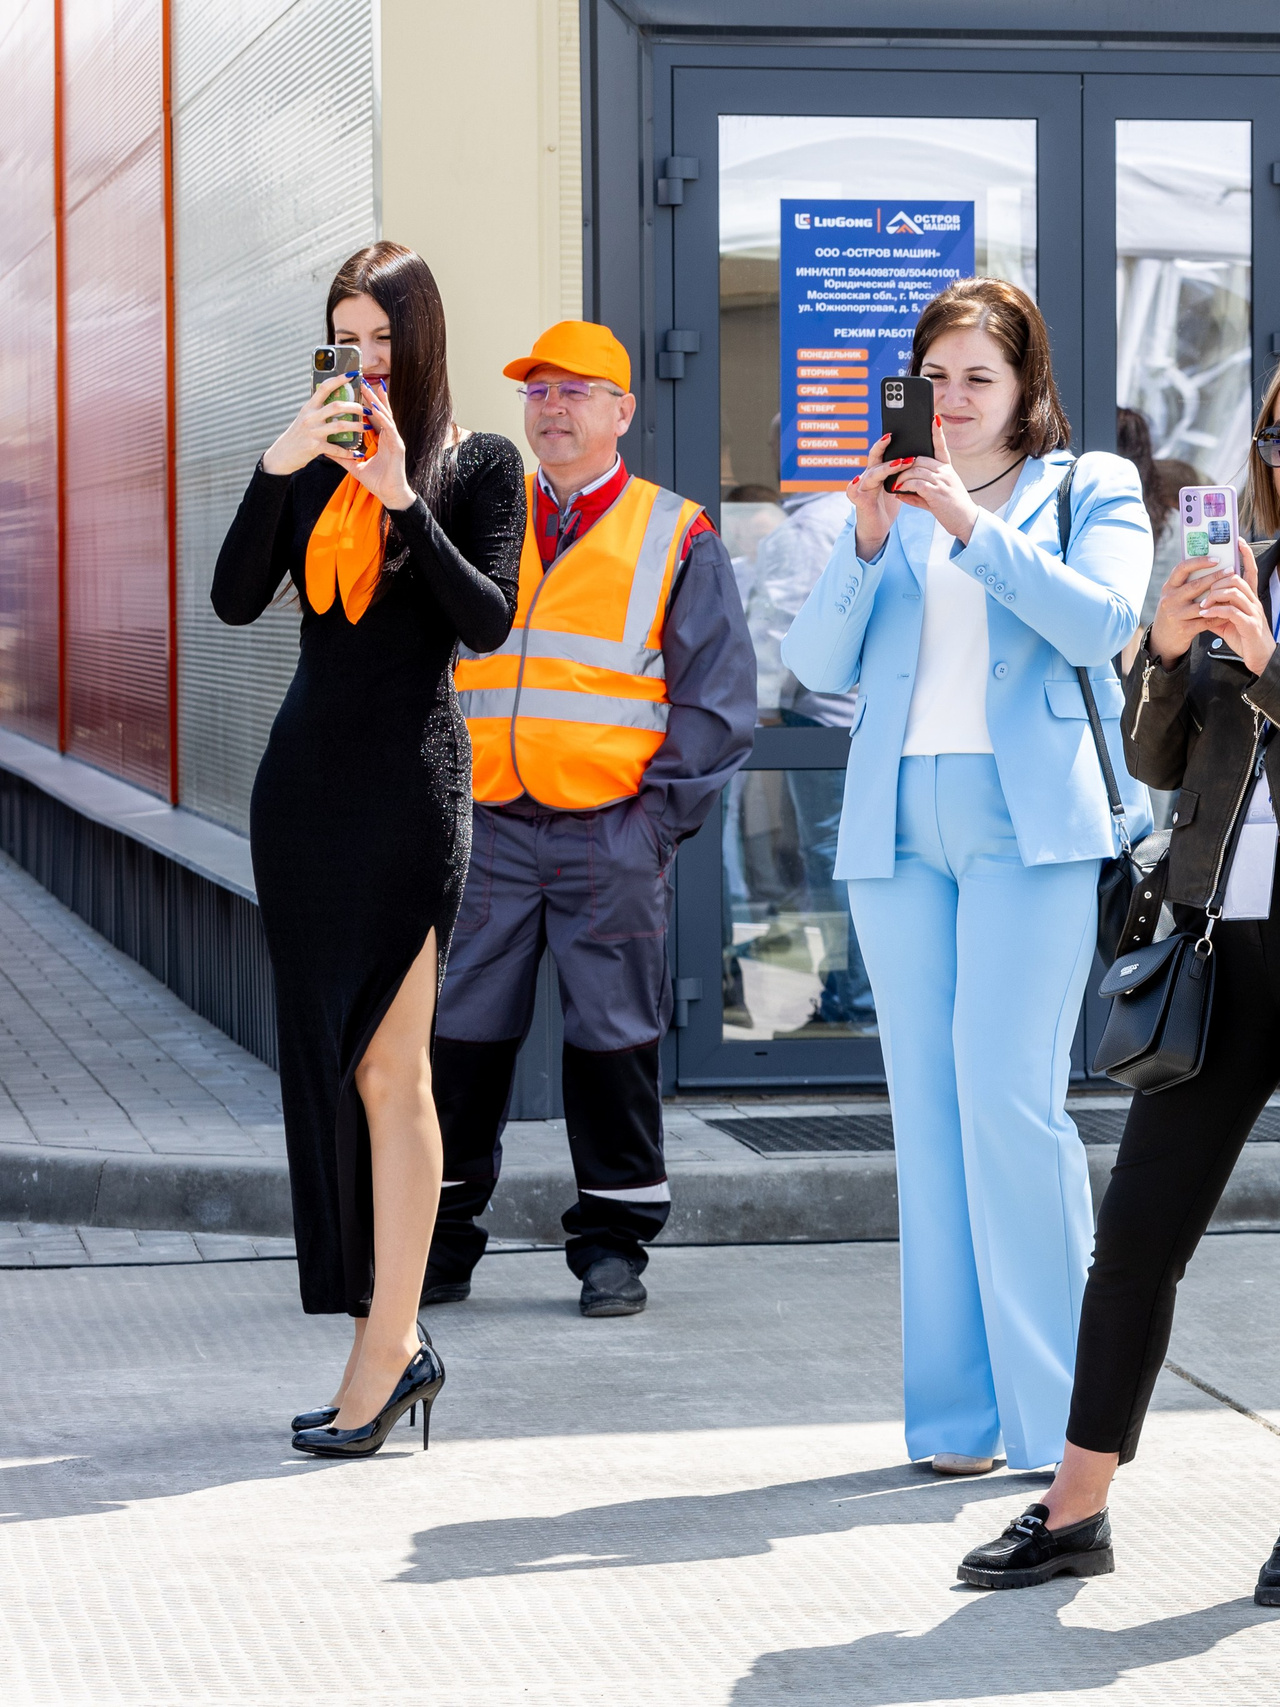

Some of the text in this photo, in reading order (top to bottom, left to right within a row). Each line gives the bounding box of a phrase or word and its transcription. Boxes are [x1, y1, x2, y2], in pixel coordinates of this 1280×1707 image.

[913, 214, 961, 224] ОСТРОВ
[923, 223, 961, 232] МАШИН
[814, 248, 941, 259] ООО «ОСТРОВ МАШИН»
[795, 267, 846, 278] ИНН/КПП
[823, 279, 932, 291] Юридический адрес:
[806, 291, 871, 301] Московская
[908, 291, 937, 302] Моск
[798, 304, 813, 315] ул.
[815, 303, 898, 314] Южнопортовая,
[899, 304, 910, 314] д.
[833, 328, 876, 338] РЕЖИМ
[801, 350, 861, 360] ПОНЕДЕЛЬНИК
[801, 368, 839, 377] ВТОРНИК
[801, 386, 829, 396] СРЕДА
[801, 404, 836, 412] ЧЕТВЕРГ
[801, 422, 840, 431] ПЯТНИЦА
[801, 440, 839, 448] СУББОТА
[801, 457, 860, 466] ВОСКРЕСЕНЬЕ
